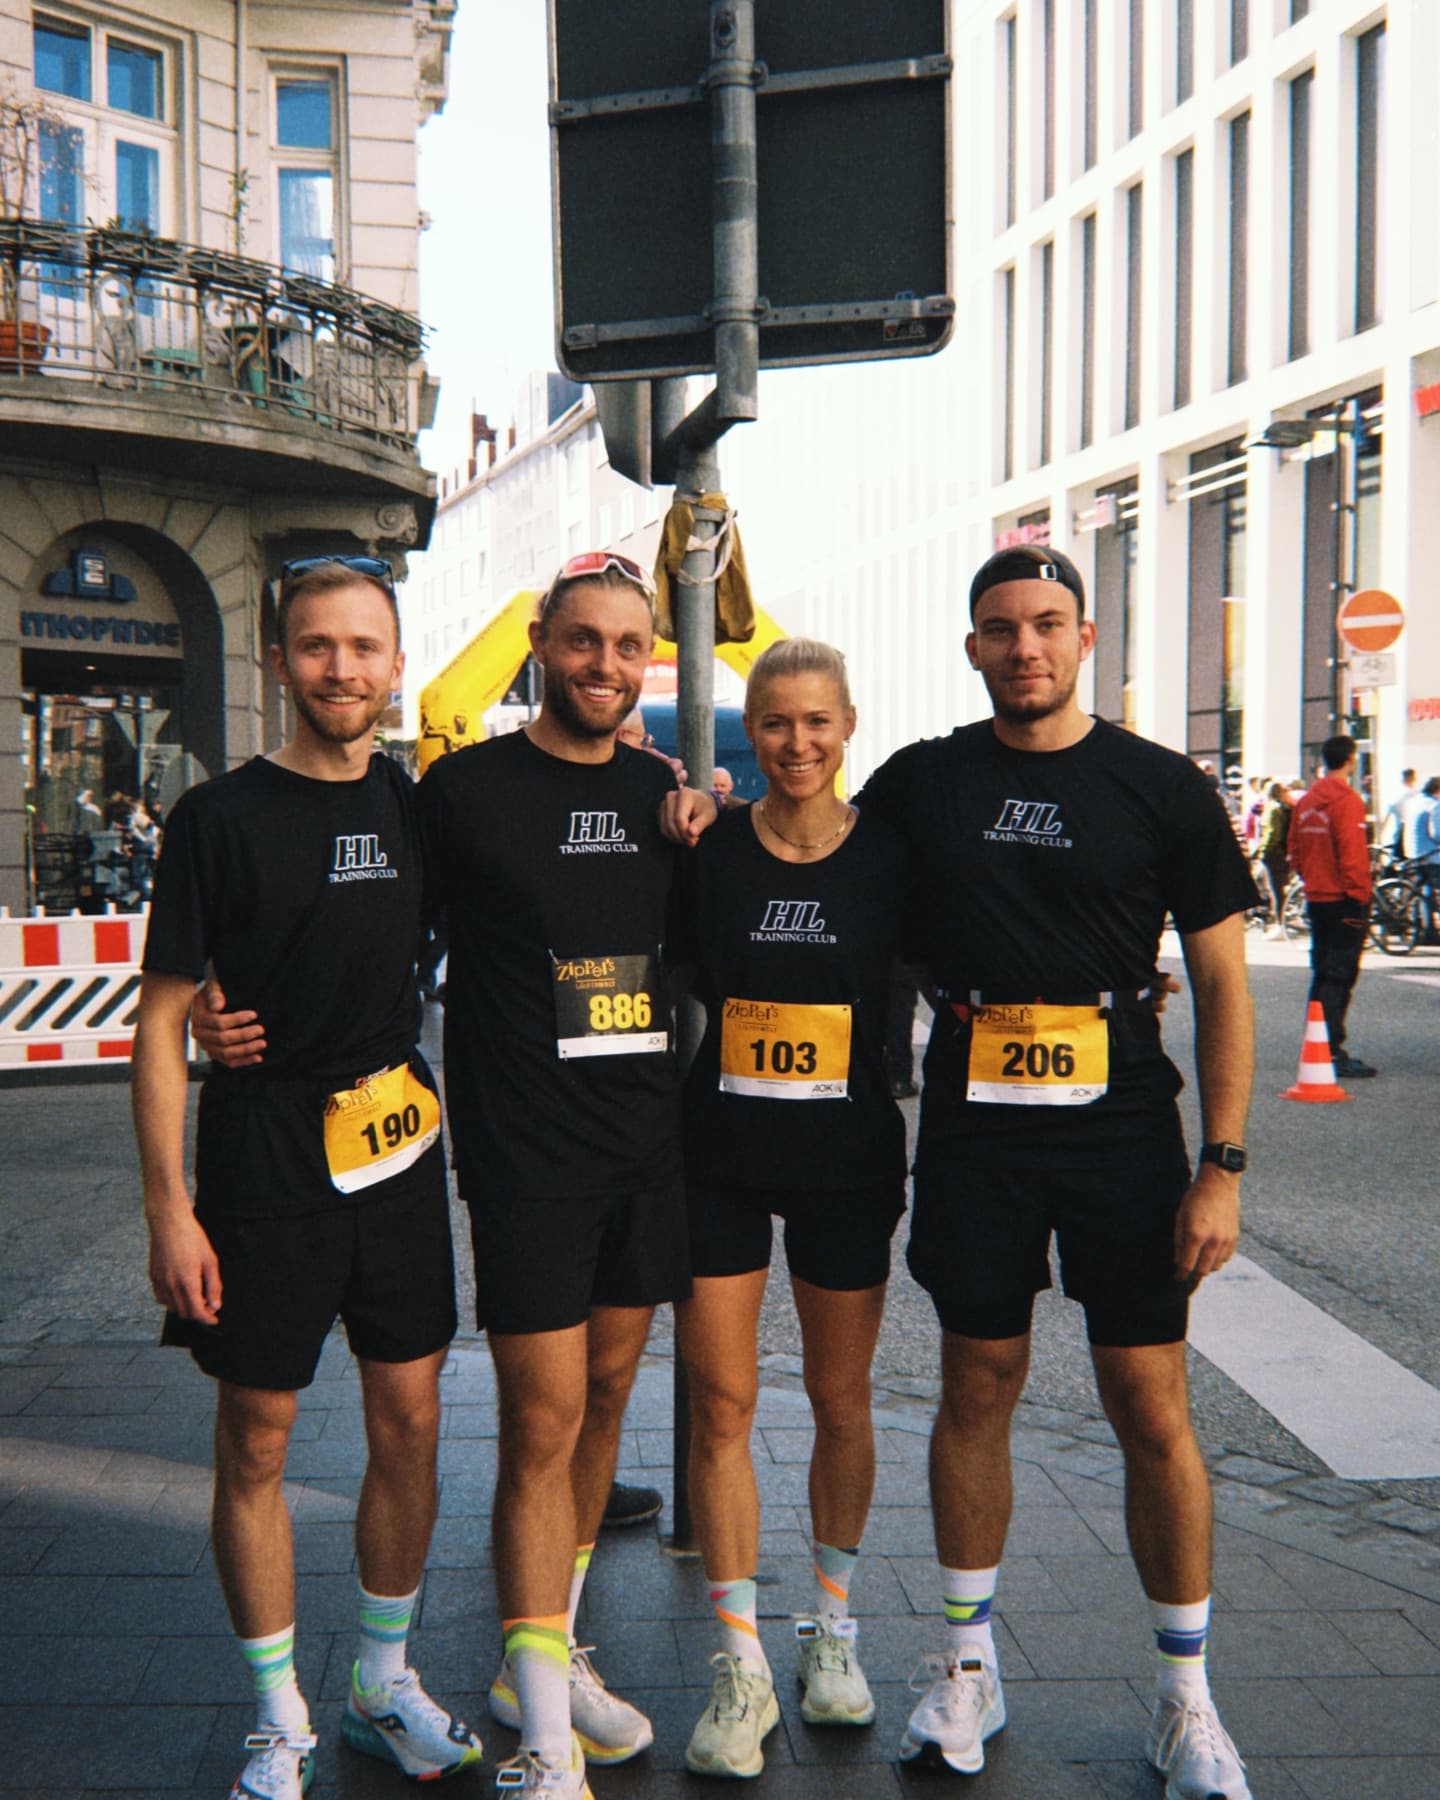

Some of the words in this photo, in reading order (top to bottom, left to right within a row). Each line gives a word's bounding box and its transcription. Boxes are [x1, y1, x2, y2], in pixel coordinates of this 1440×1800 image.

[568, 811, 626, 843] HL
[994, 799, 1063, 836] HL
[334, 834, 388, 871] HL
[558, 843, 611, 854] TRAINING
[612, 842, 639, 853] CLUB
[982, 830, 1040, 845] TRAINING
[1041, 836, 1072, 848] CLUB
[328, 869, 377, 883] TRAINING
[760, 900, 826, 932] HL
[749, 932, 805, 943] TRAINING
[806, 933, 838, 944] CLUB
[589, 992, 652, 1031] 886
[750, 1038, 817, 1075] 103
[1001, 1041, 1076, 1078] 206
[812, 1084, 834, 1093] AOK
[360, 1103, 421, 1156] 190
